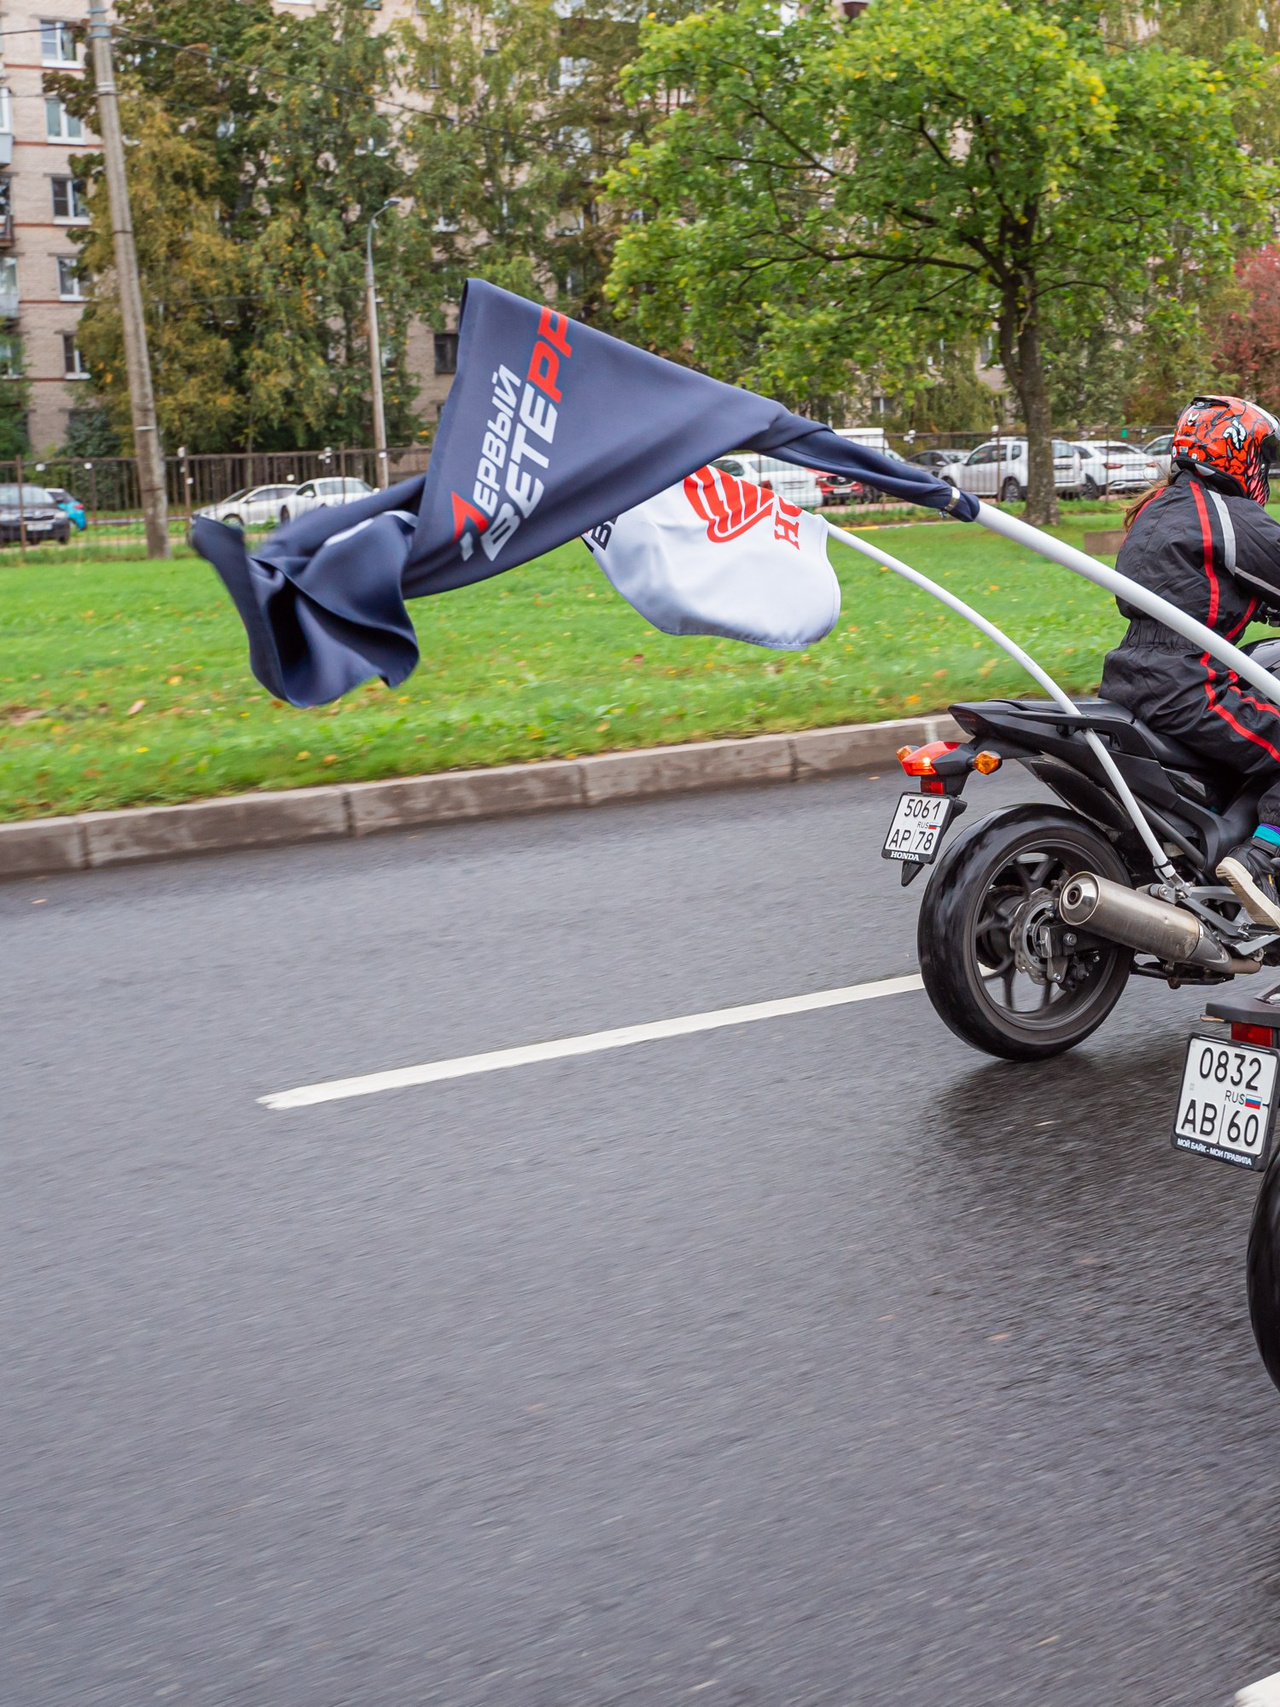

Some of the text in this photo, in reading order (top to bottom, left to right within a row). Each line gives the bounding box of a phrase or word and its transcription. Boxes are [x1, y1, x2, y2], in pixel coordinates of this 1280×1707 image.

[904, 798, 942, 820] 5061
[916, 821, 929, 829] RUS
[914, 830, 934, 851] 78
[890, 851, 920, 861] HONDA
[1199, 1047, 1262, 1092] 0832
[1224, 1090, 1246, 1106] RUS
[1227, 1109, 1259, 1147] 60
[1177, 1138, 1191, 1149] МОЙ
[1191, 1141, 1207, 1152] БАЙК
[1223, 1150, 1253, 1166] ПРАВИЛА
